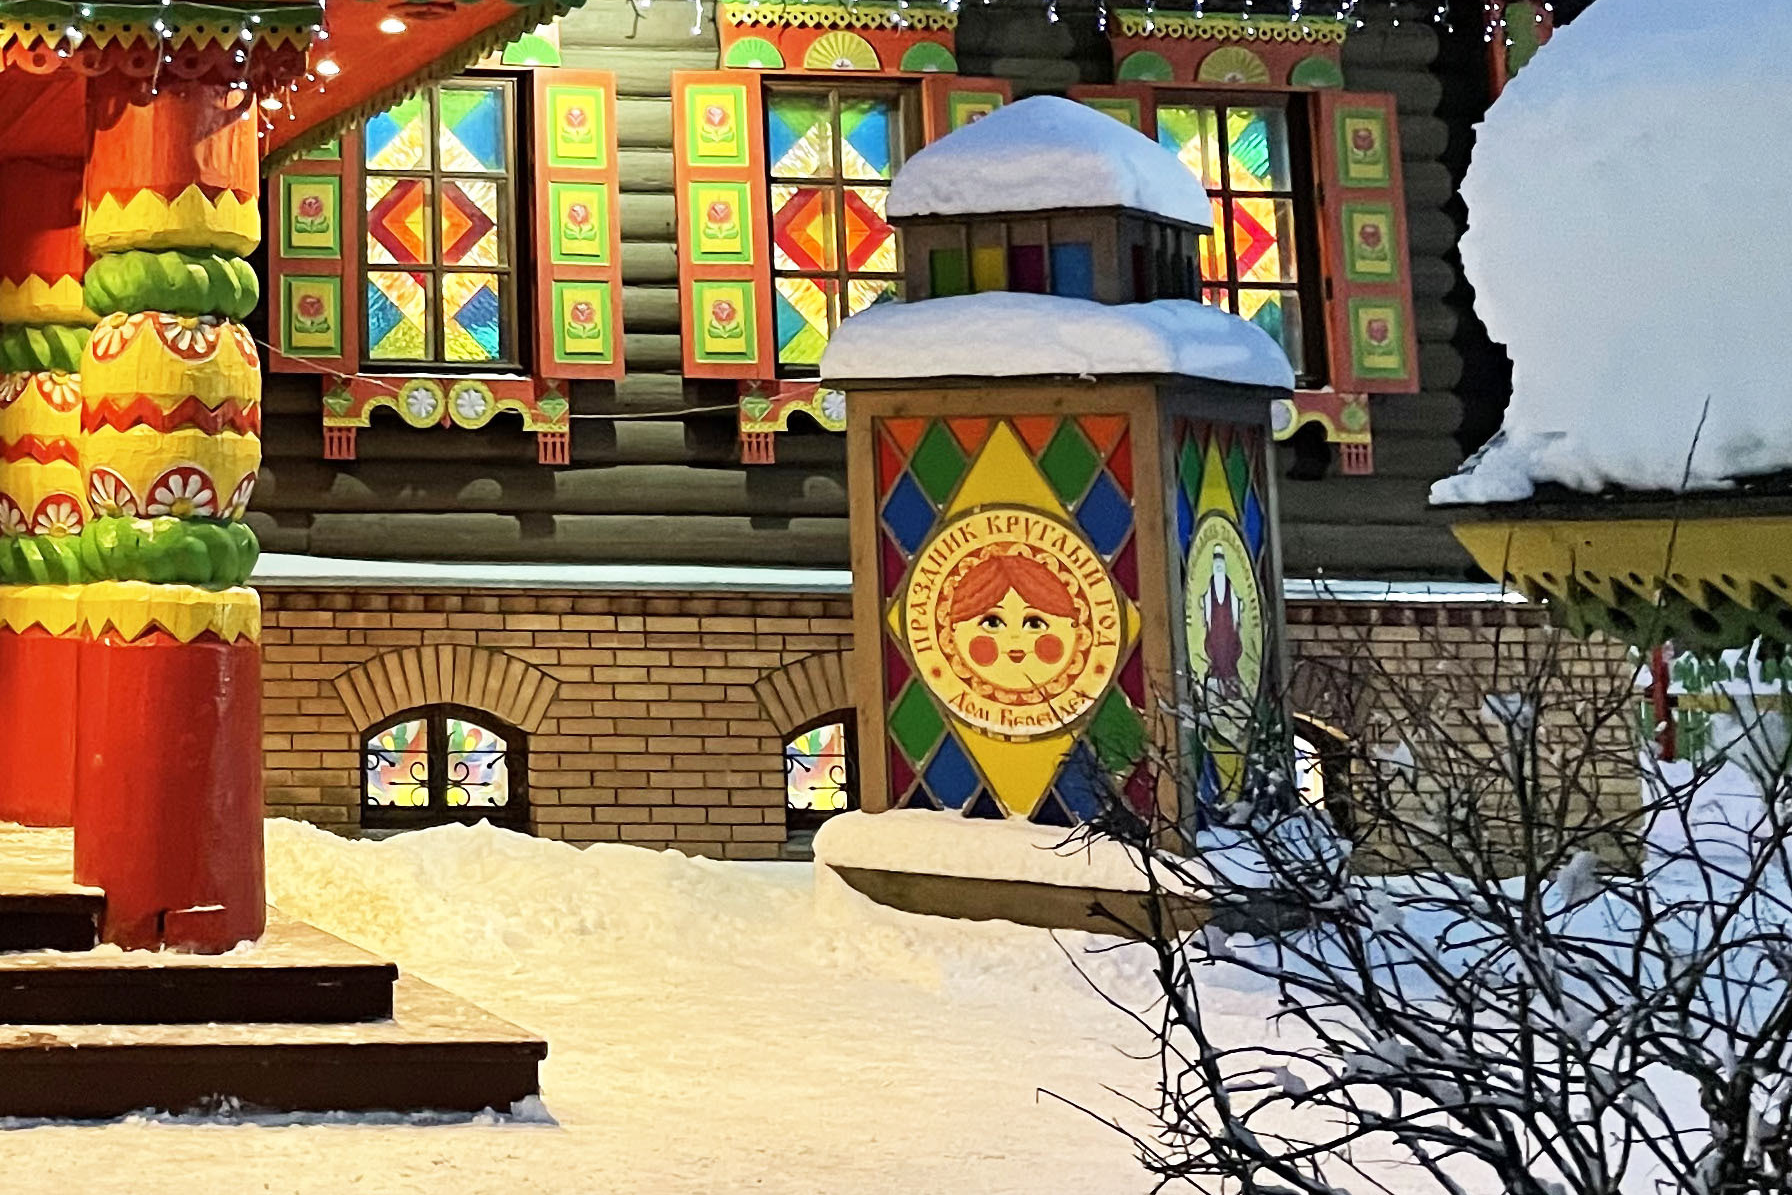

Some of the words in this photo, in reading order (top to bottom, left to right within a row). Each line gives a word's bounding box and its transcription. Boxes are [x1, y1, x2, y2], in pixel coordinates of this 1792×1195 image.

[910, 522, 978, 653] ПРАЗДНИК
[986, 515, 1106, 588] КРУГЛЫЙ
[1094, 599, 1117, 648] ГОД
